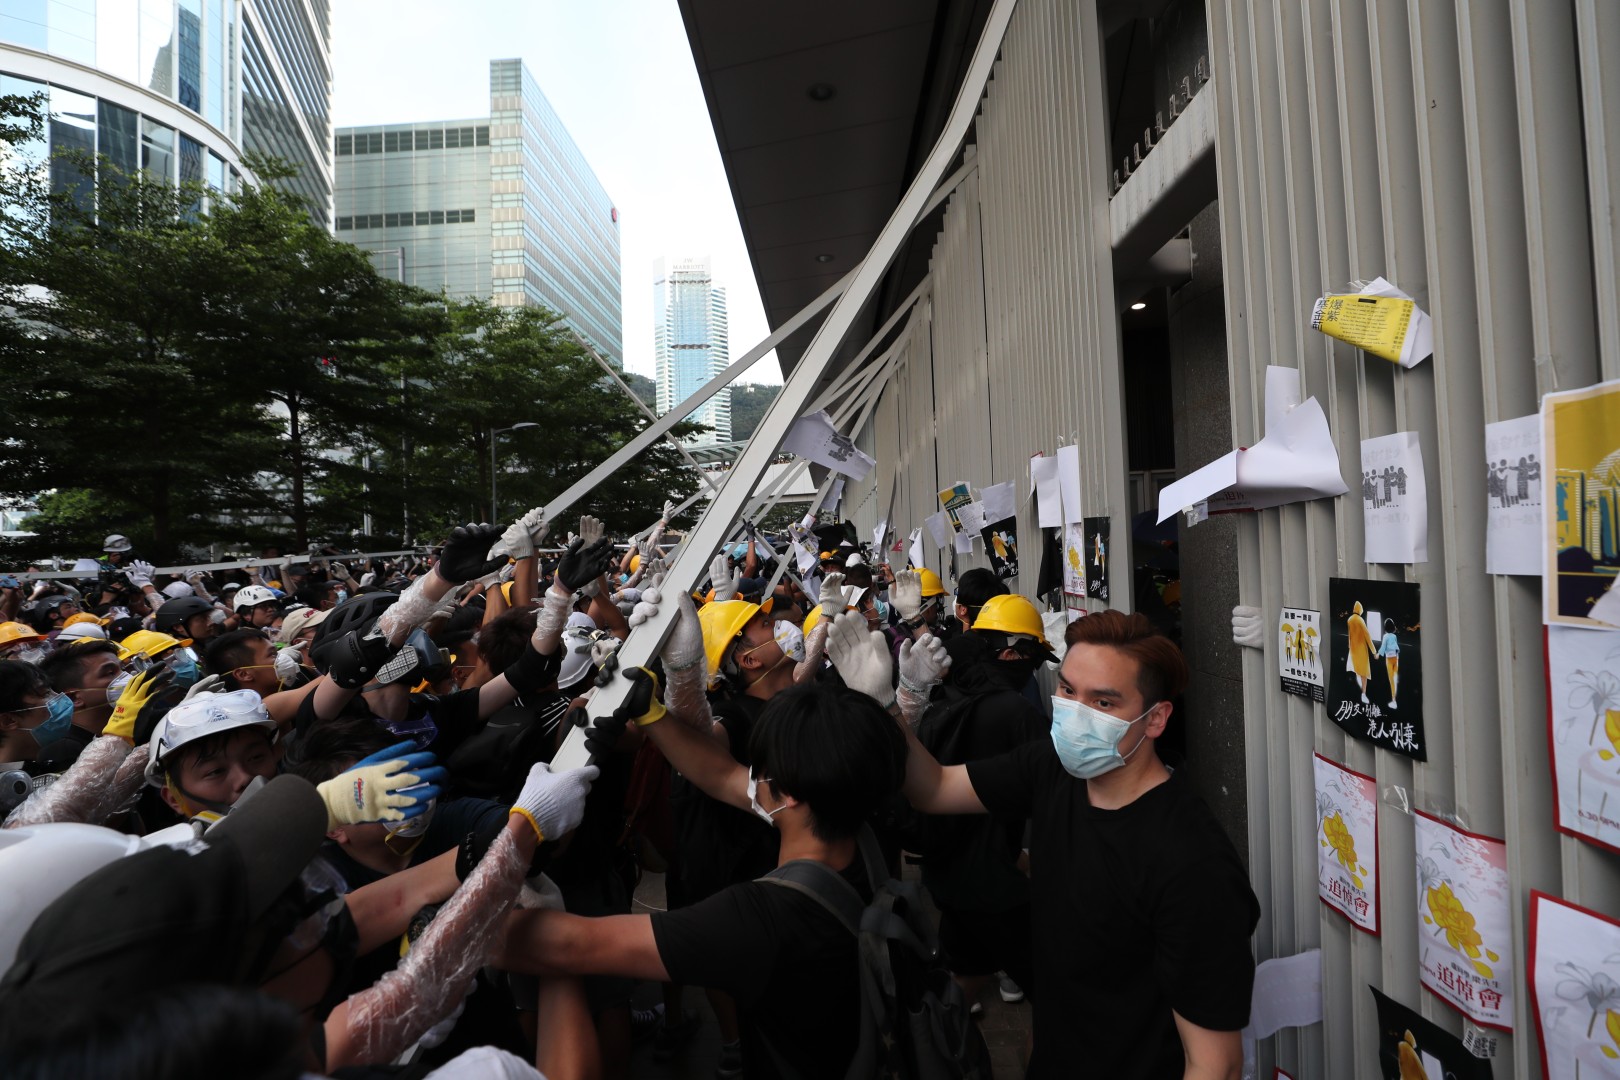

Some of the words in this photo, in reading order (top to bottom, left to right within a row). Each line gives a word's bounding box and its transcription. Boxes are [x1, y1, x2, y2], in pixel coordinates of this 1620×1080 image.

[1328, 876, 1370, 917] 追悼會
[1436, 961, 1504, 1011] 追悼會
